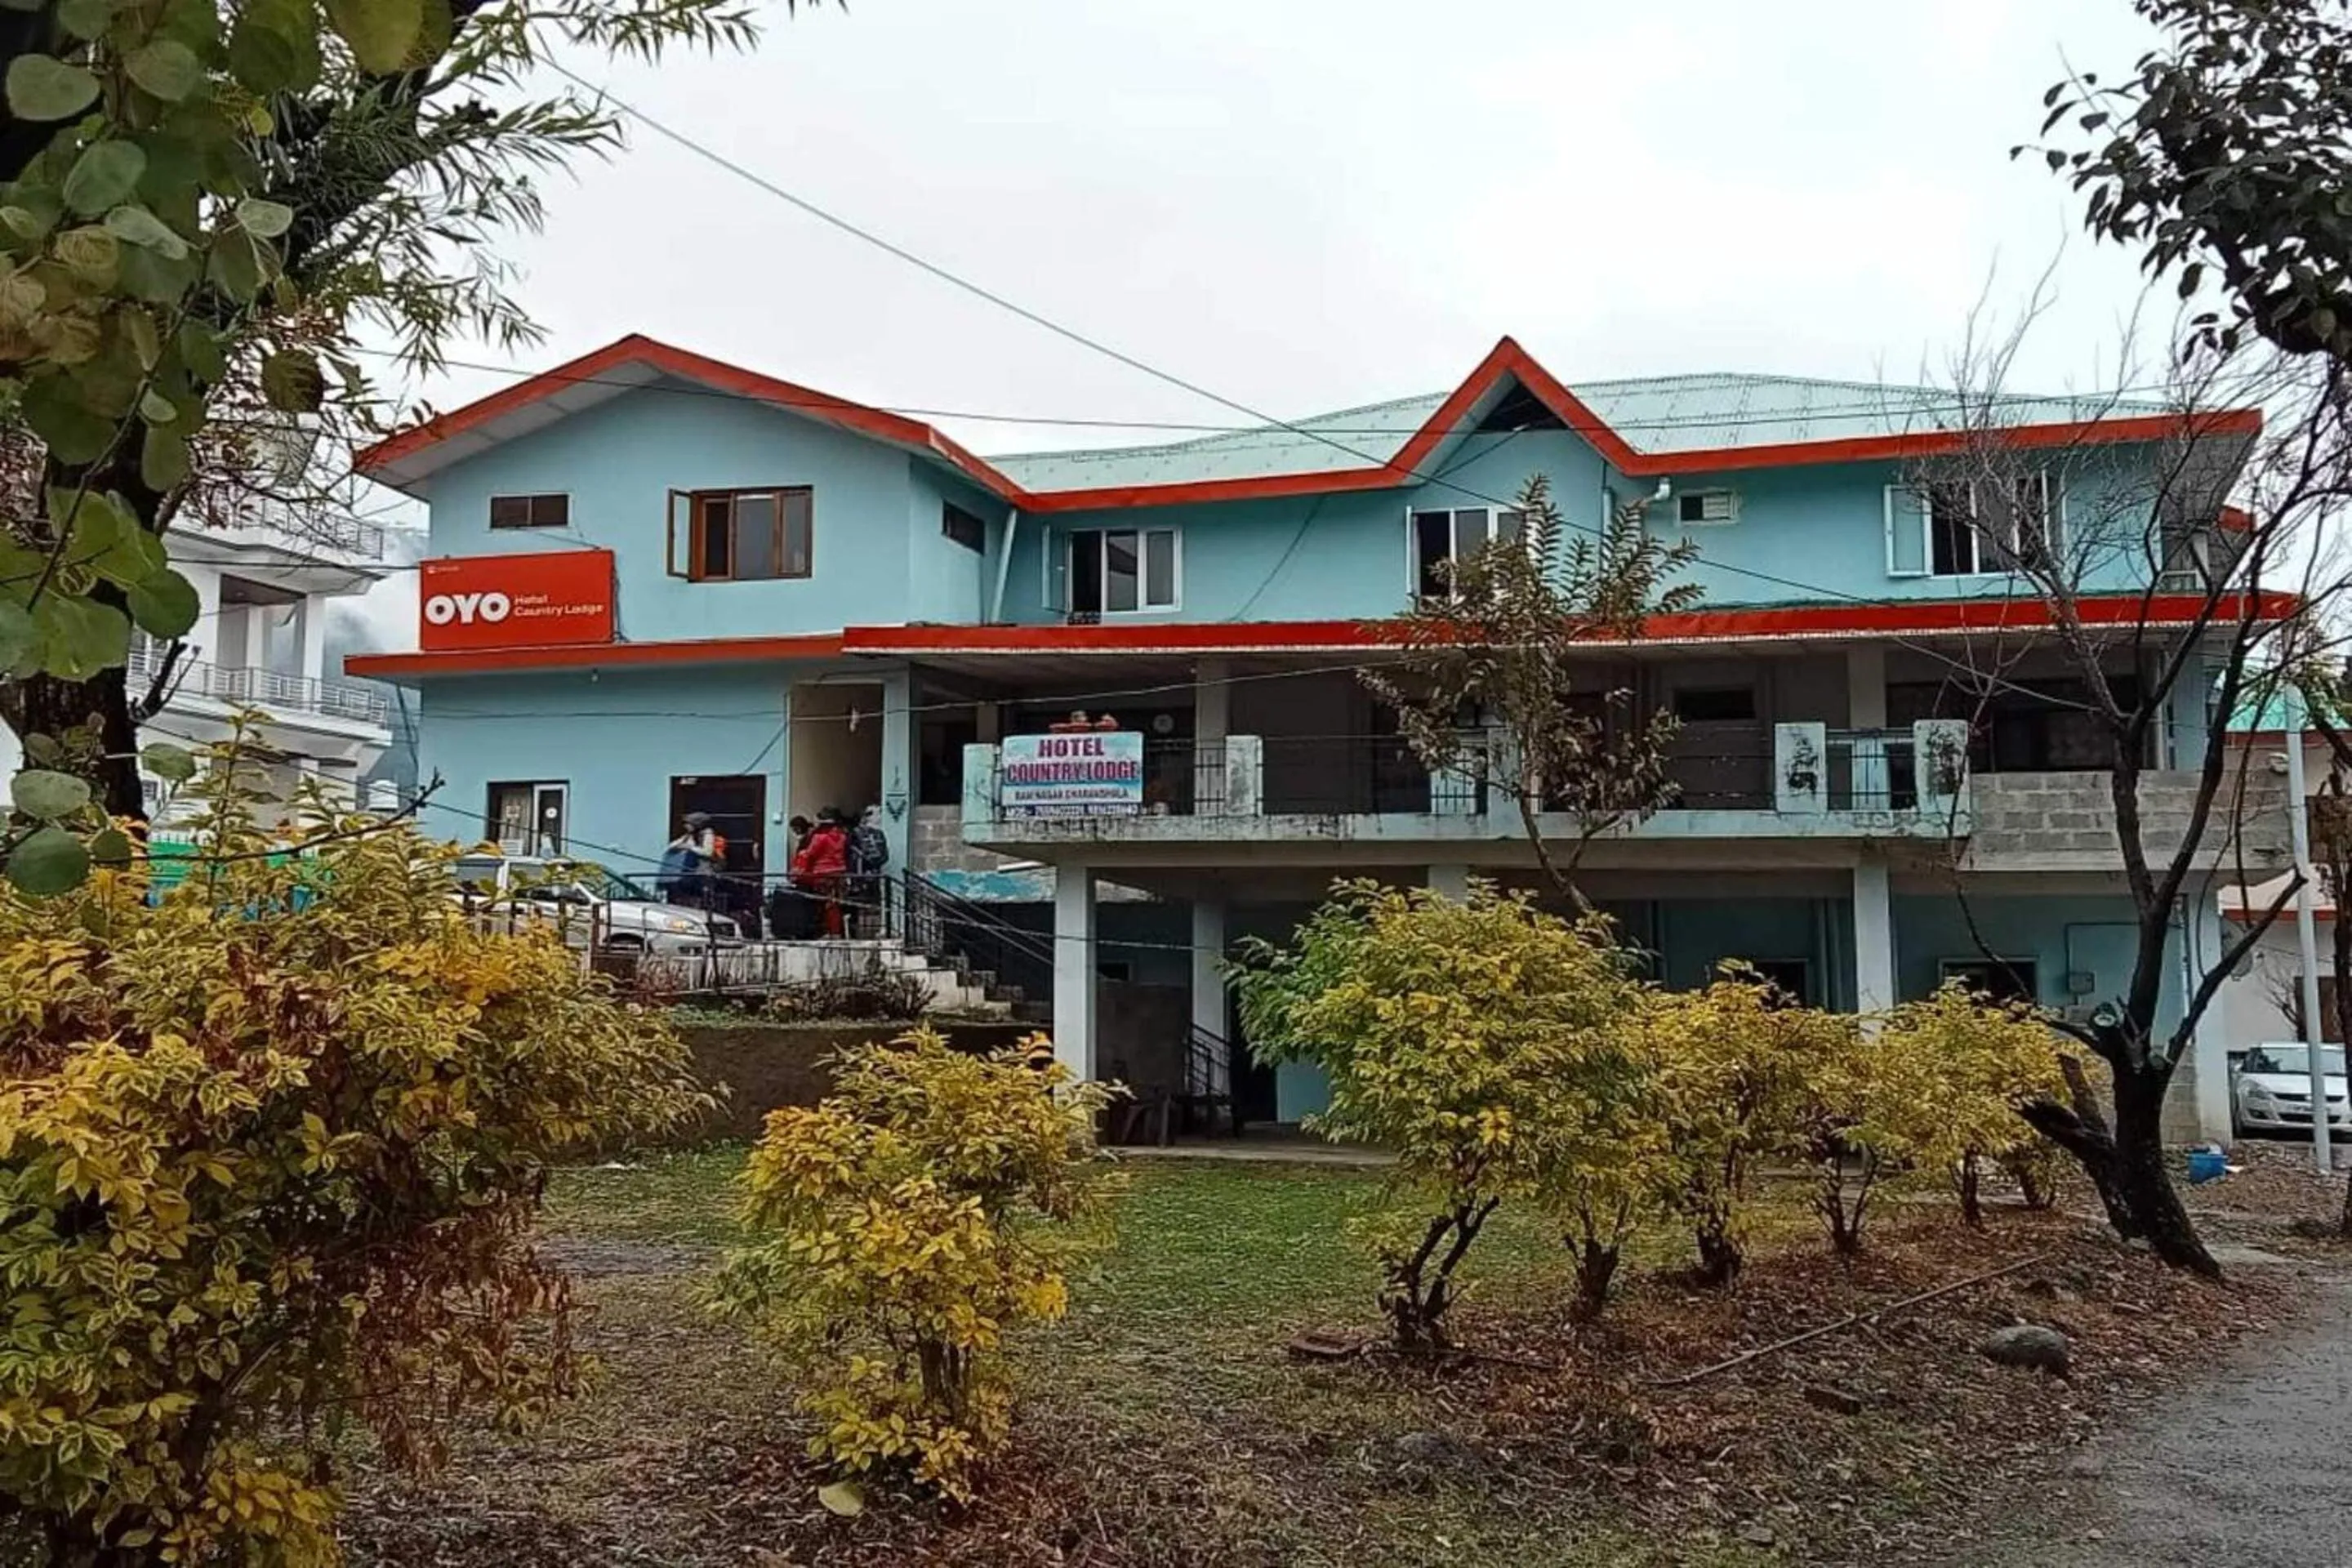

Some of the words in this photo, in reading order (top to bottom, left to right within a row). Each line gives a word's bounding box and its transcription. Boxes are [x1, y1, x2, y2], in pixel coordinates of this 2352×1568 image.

[425, 592, 510, 625] OYO
[514, 604, 564, 617] Country
[1038, 737, 1105, 757] HOTEL
[1008, 760, 1083, 783] COUNTRY
[1087, 760, 1138, 780] LODGE
